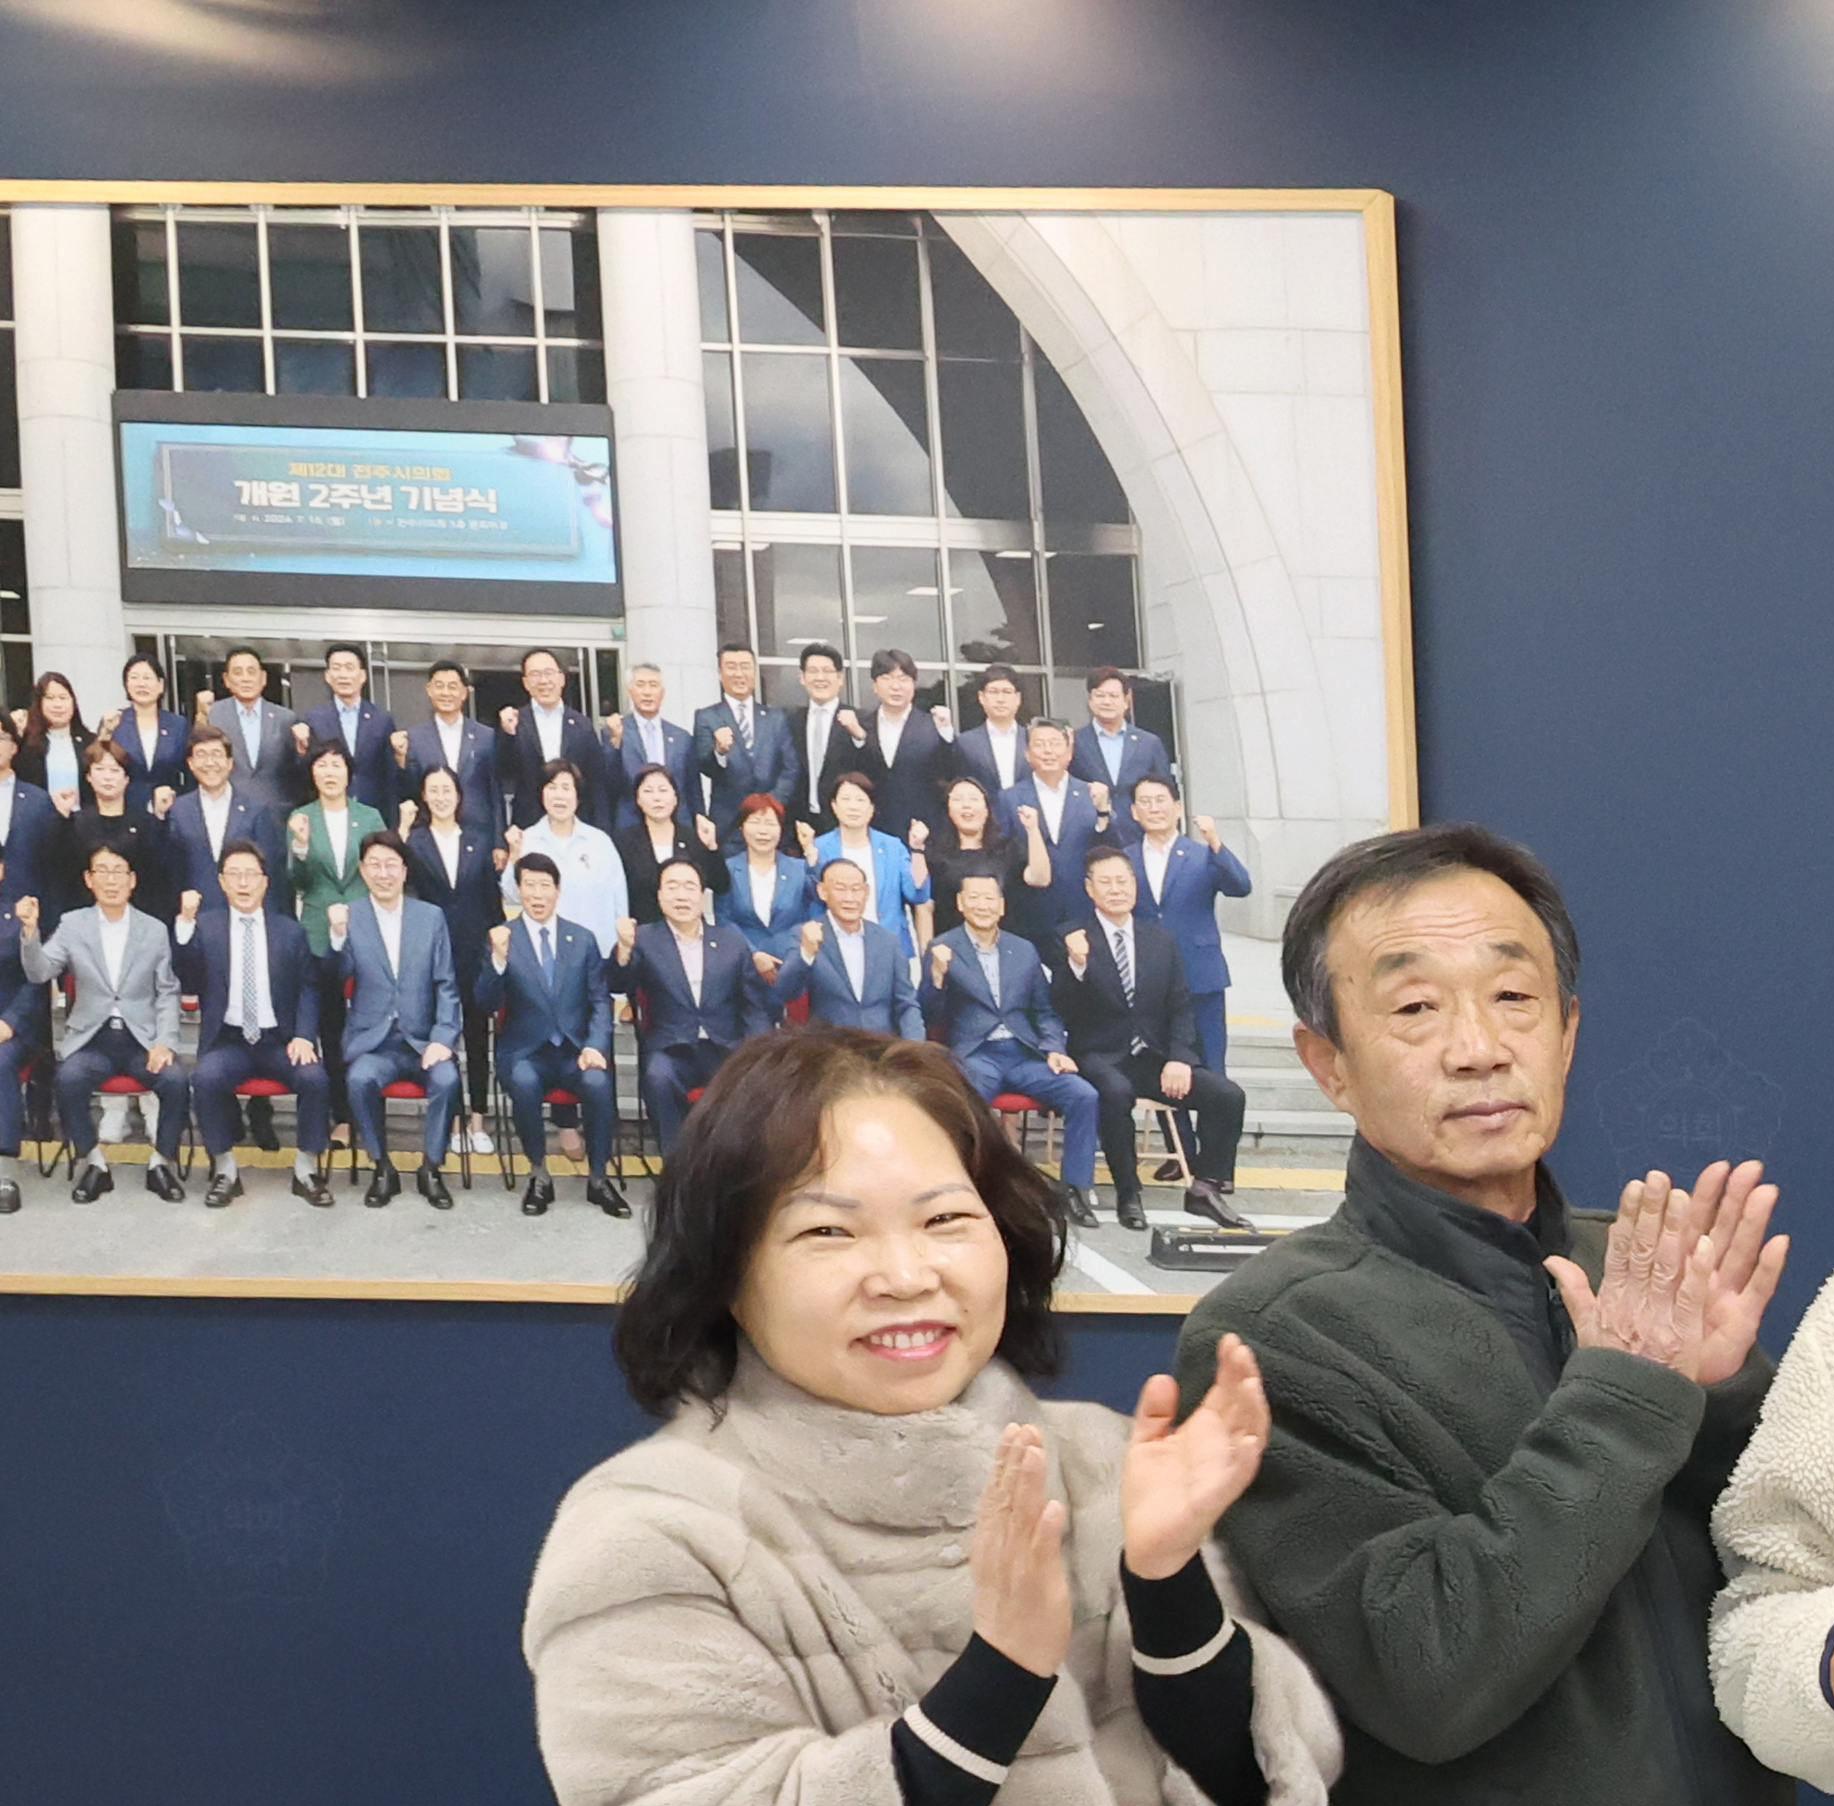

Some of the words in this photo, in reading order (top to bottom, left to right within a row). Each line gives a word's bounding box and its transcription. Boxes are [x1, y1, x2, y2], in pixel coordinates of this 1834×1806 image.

[233, 480, 301, 507] 개원
[307, 482, 393, 511] 2주년
[400, 485, 498, 513] 기념식
